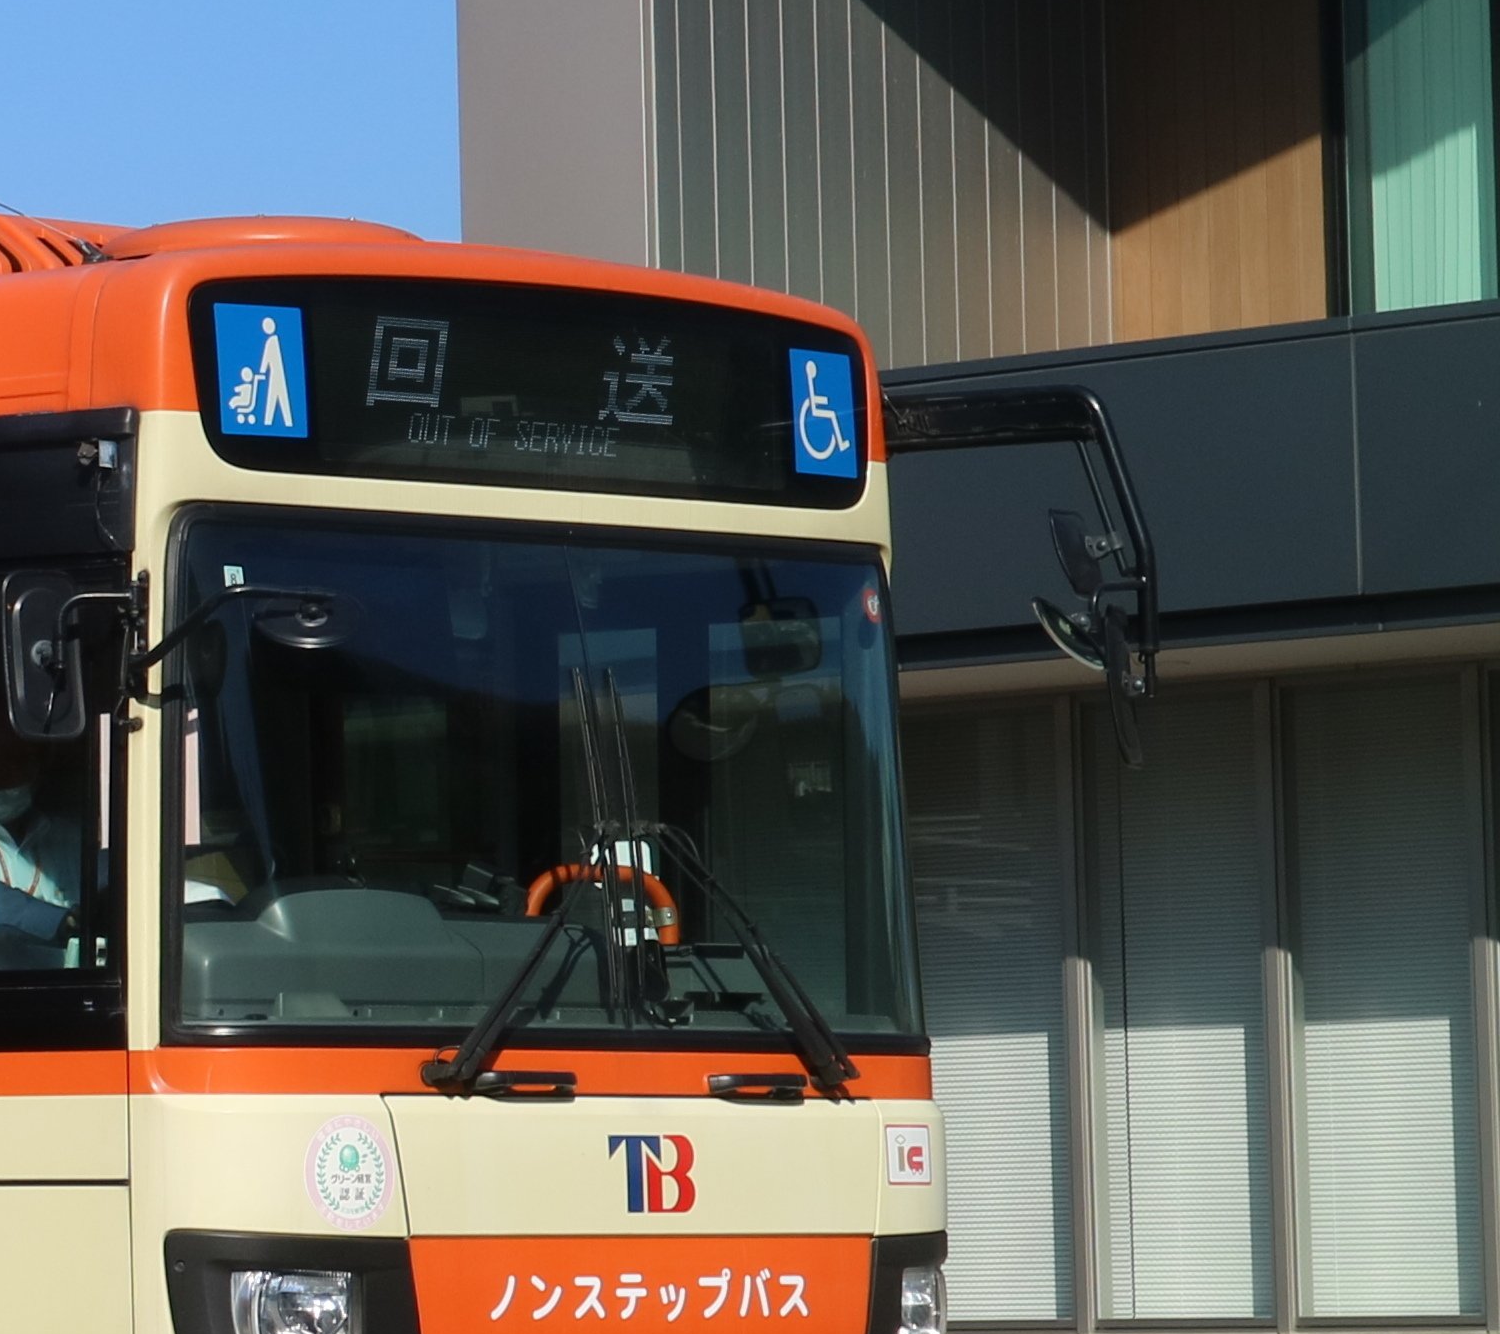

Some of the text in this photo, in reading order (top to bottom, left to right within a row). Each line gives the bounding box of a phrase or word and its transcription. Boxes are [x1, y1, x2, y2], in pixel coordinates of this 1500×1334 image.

[408, 412, 620, 458] OUT OF SERVICE
[489, 1268, 809, 1322] ノンステップバス
